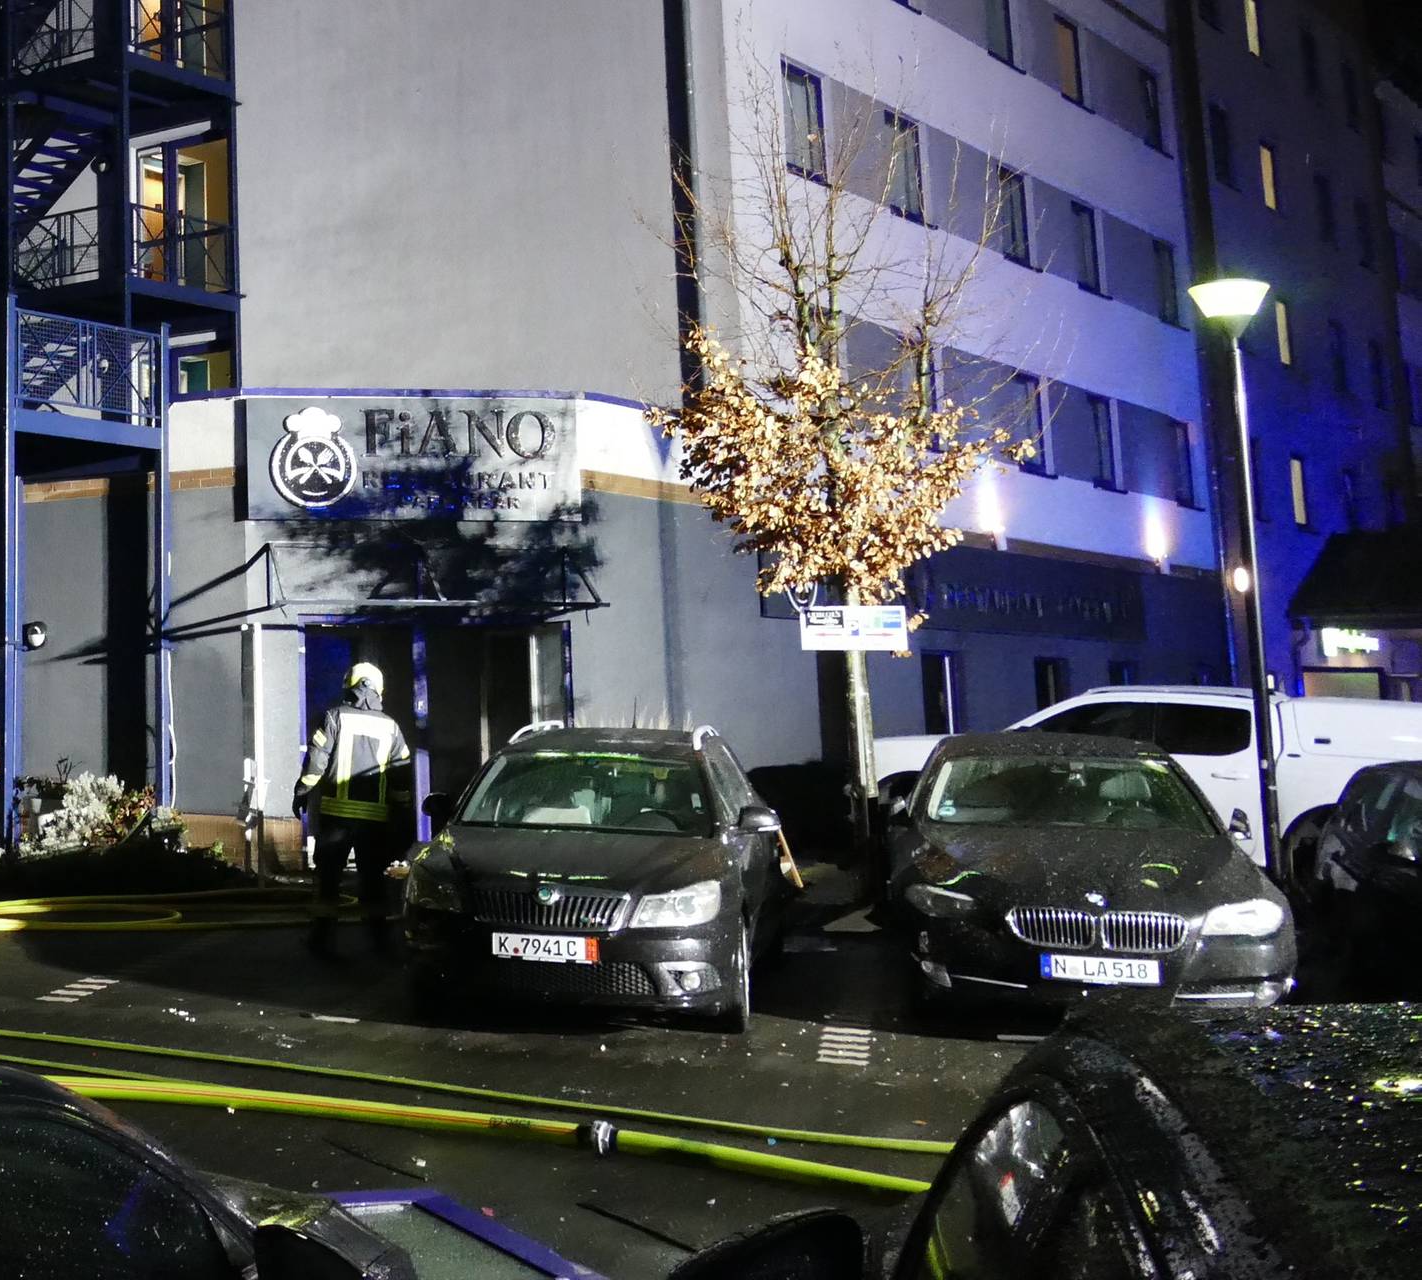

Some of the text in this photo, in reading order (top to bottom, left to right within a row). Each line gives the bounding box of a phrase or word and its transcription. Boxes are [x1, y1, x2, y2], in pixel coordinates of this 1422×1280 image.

[362, 470, 556, 490] REURANT
[498, 936, 509, 953] K
[1054, 958, 1067, 974] N
